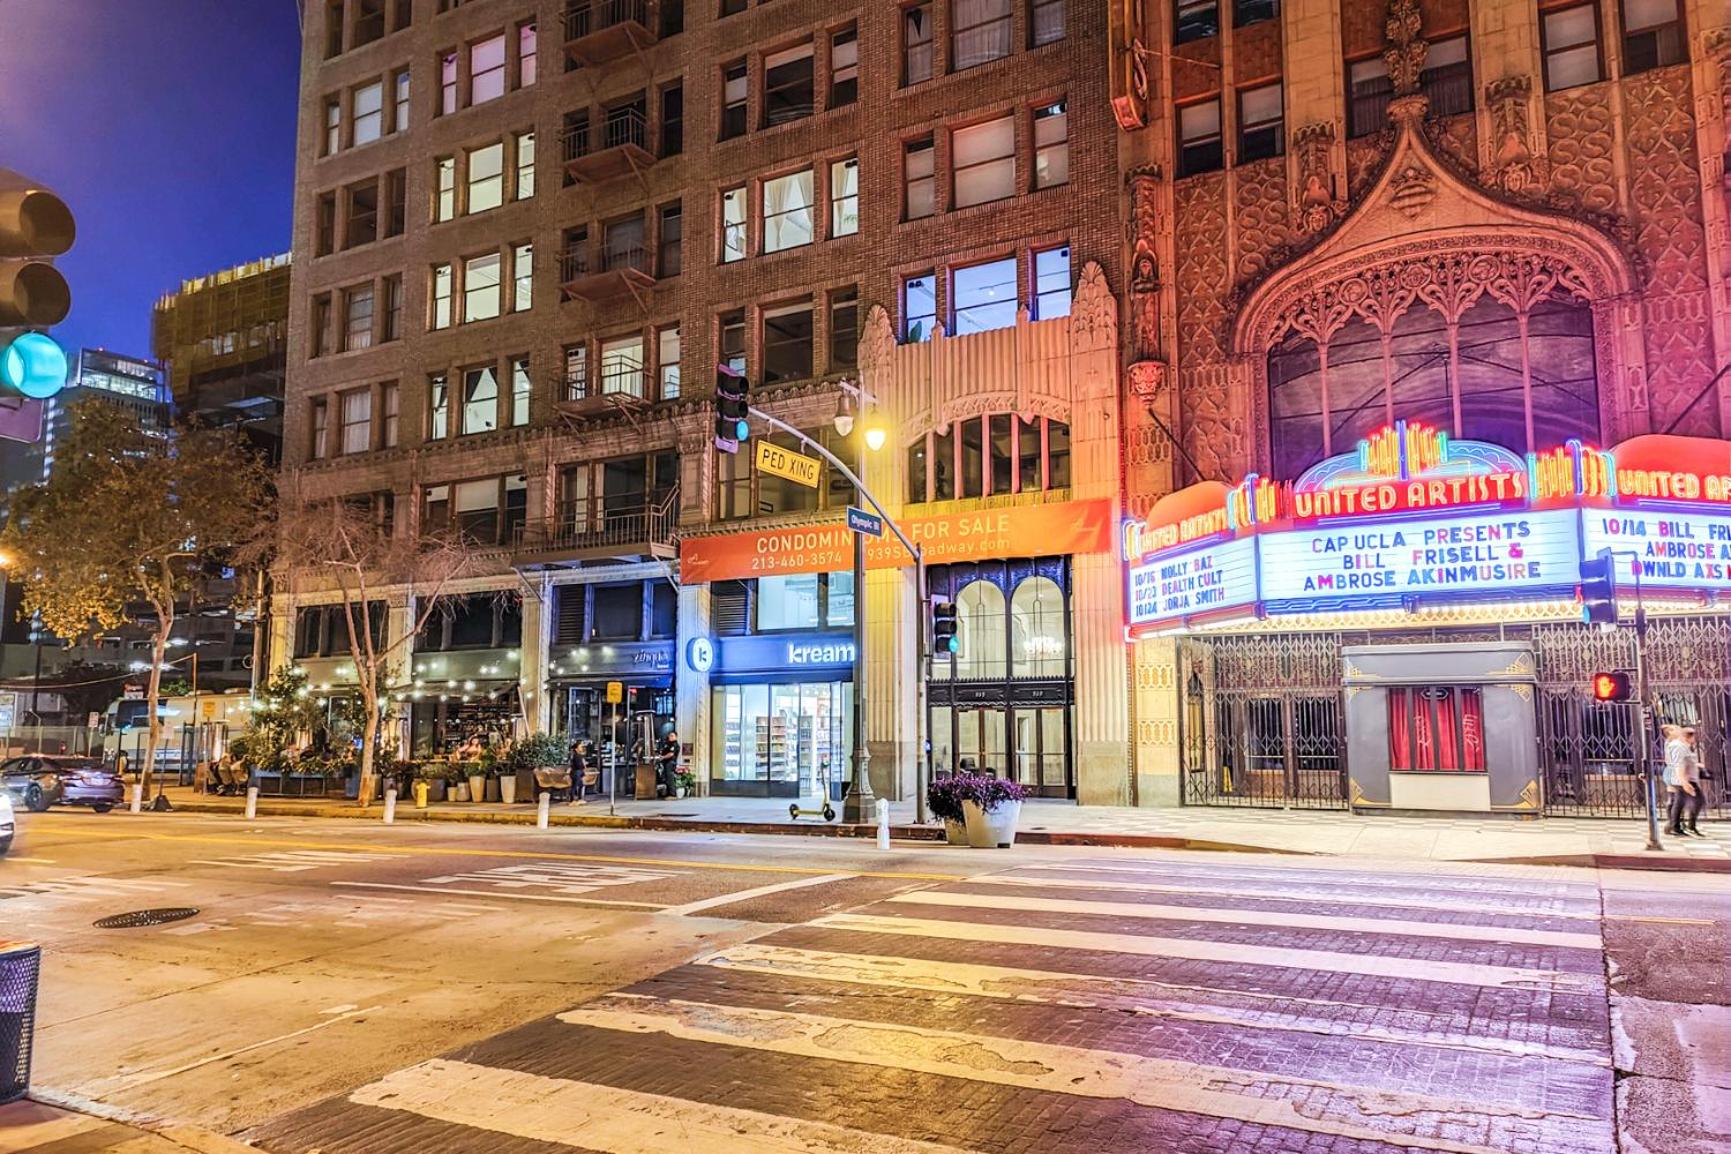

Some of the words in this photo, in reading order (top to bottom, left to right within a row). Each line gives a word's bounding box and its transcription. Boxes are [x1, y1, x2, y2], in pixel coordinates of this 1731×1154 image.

[763, 449, 785, 469] PED
[790, 459, 814, 480] XING
[1618, 469, 1700, 498] UNITED
[1295, 485, 1397, 518] UNITED
[1407, 471, 1524, 508] ARTISTS
[912, 520, 949, 540] FOR
[959, 514, 1010, 536] SALE
[1312, 536, 1348, 553] CAP
[1354, 531, 1407, 550] UCLA
[1424, 521, 1531, 545] PRESENTS
[1603, 518, 1647, 536] 10/14
[1658, 521, 1695, 539] BILL
[752, 551, 843, 570] 213-460-3574
[1343, 553, 1386, 570] BILL
[1412, 545, 1499, 565] FRISELL
[1508, 542, 1524, 559] &
[1645, 541, 1715, 559] AMBROSE
[1720, 543, 1731, 560] A
[1161, 561, 1188, 580] MOLLY
[1198, 570, 1223, 587] CULT
[1303, 570, 1397, 591] AMBROSE
[1407, 561, 1541, 585] AKINMUSIRE
[1631, 560, 1686, 578] DWNLD
[1195, 587, 1224, 605] SMITH
[698, 647, 707, 662] k
[788, 643, 855, 663] kream
